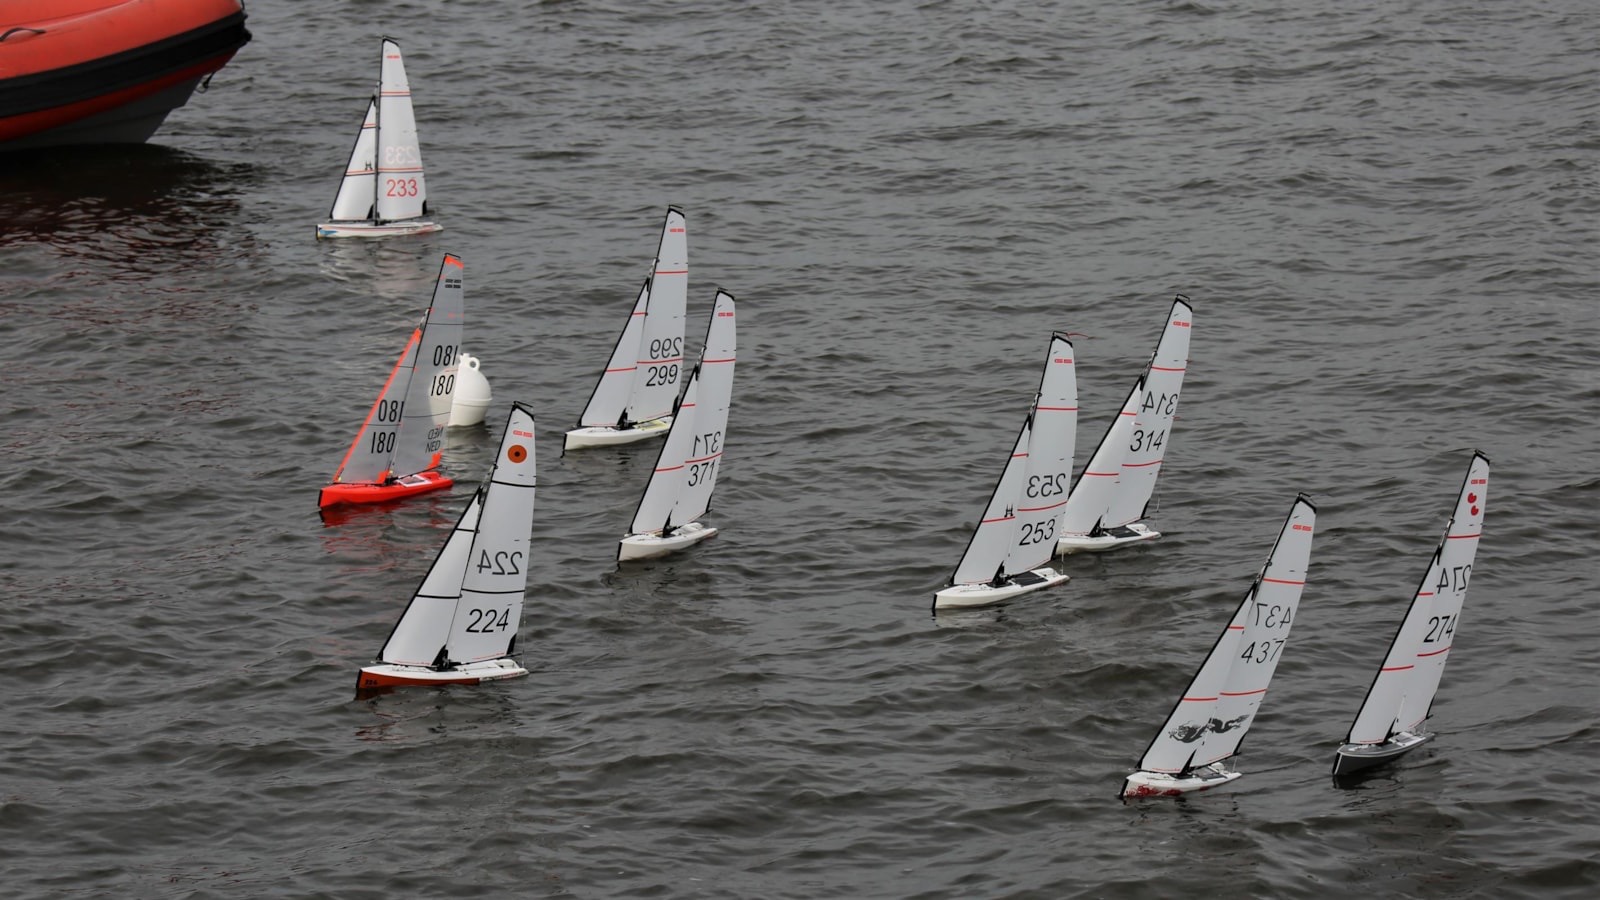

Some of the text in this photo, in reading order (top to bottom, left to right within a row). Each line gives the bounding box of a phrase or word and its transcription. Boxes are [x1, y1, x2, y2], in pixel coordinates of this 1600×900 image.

[386, 179, 418, 197] 233
[431, 374, 455, 397] 180
[646, 364, 678, 387] 299
[371, 431, 396, 454] 180
[425, 440, 441, 453] NED
[1130, 429, 1165, 452] 314
[688, 459, 716, 487] 371
[1019, 518, 1056, 546] 253
[465, 608, 510, 633] 224
[1423, 613, 1458, 643] 274
[1241, 640, 1285, 664] 437
